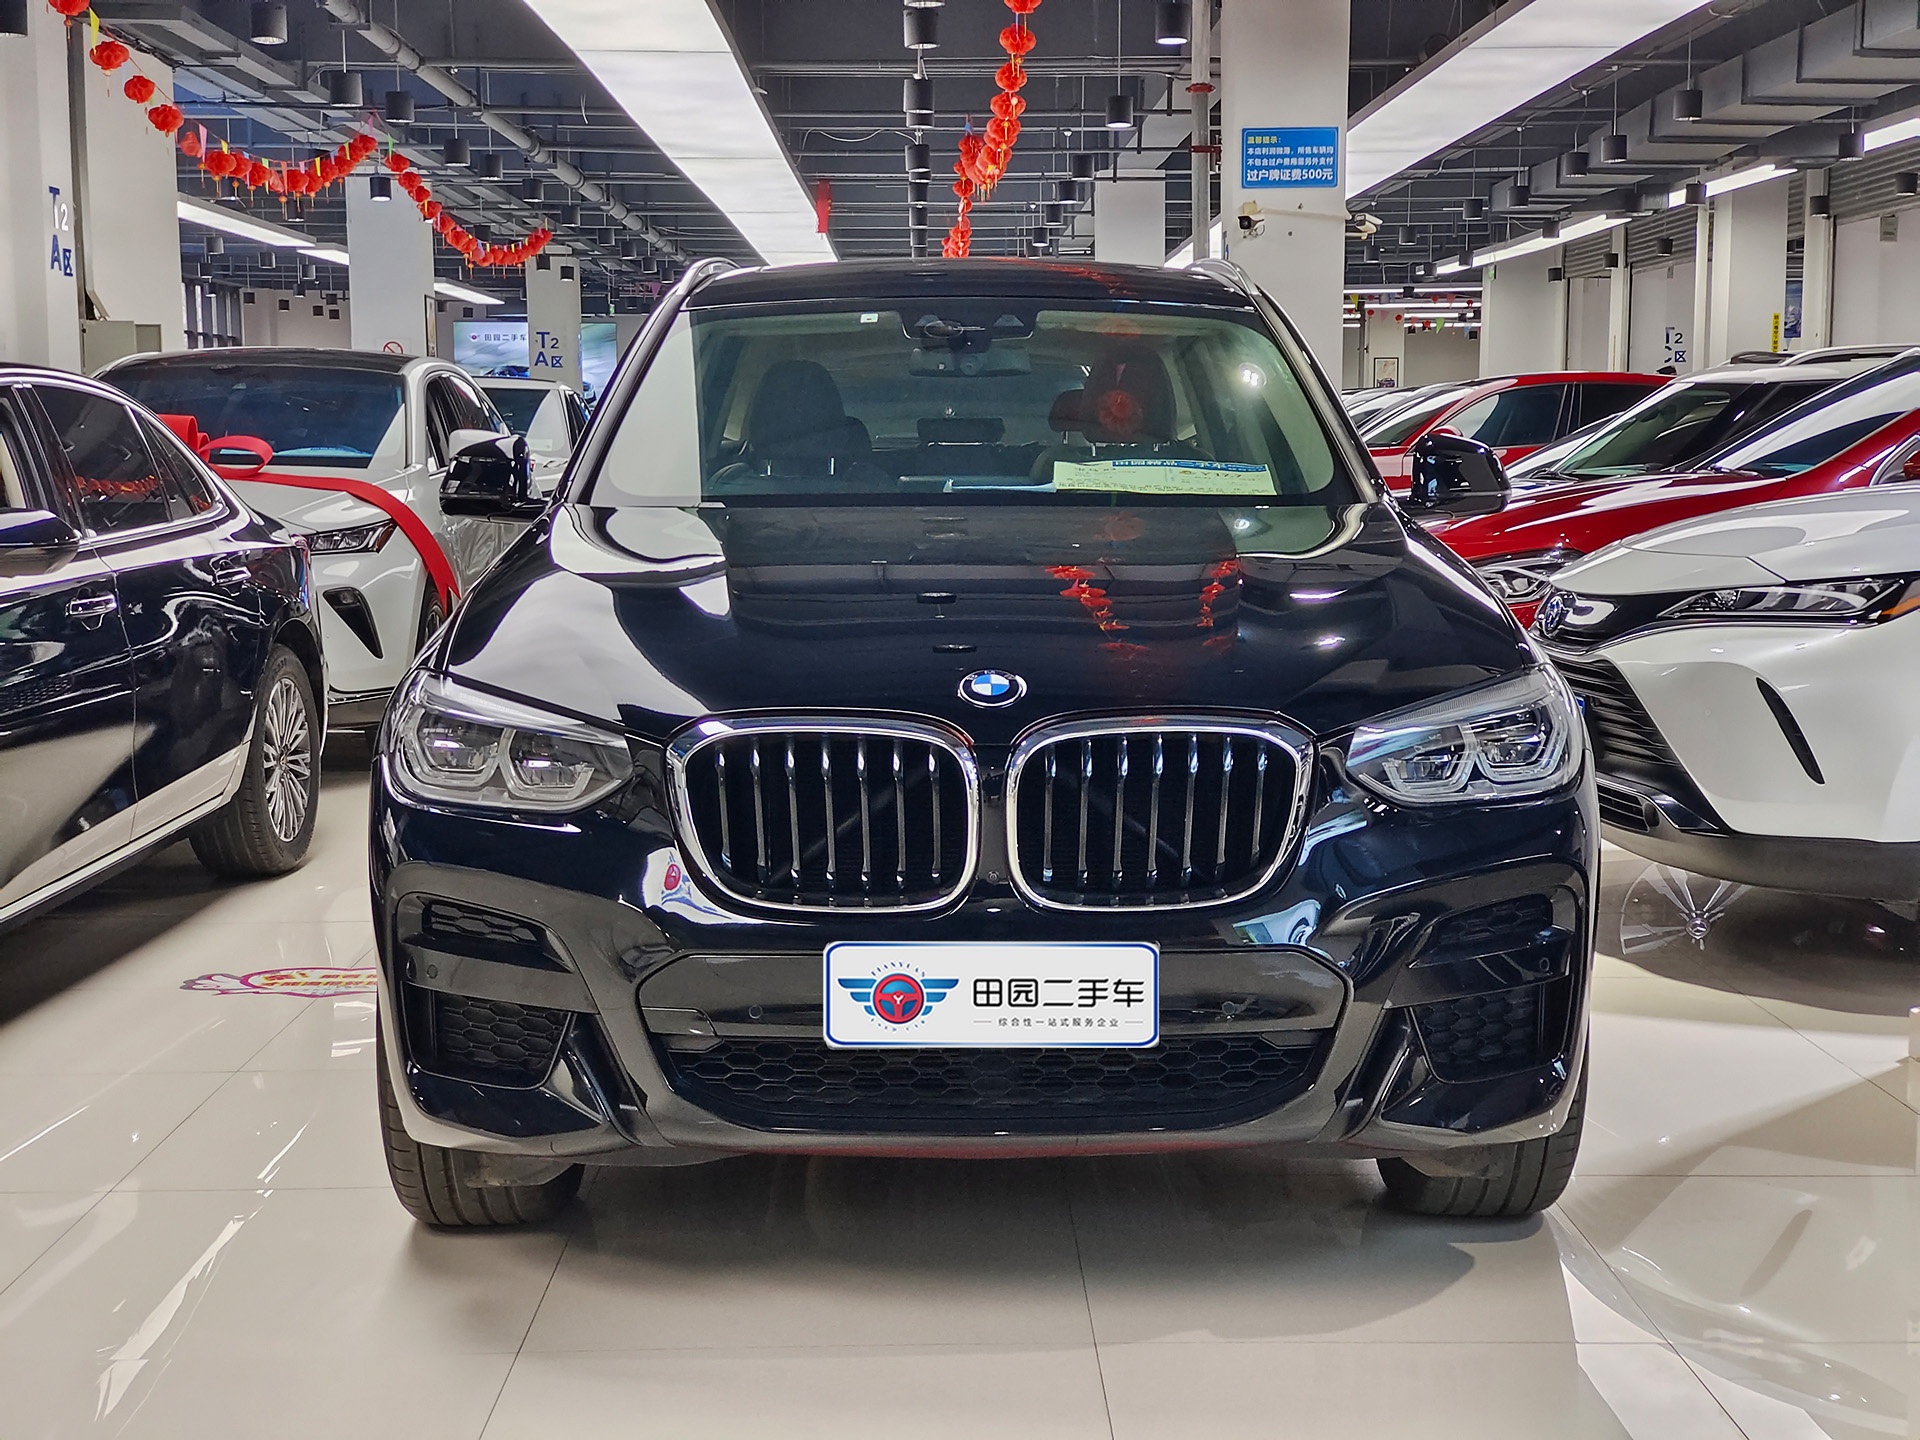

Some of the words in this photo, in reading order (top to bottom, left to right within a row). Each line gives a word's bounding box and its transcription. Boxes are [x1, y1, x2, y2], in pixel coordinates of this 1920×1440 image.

[1247, 168, 1334, 182] 过户牌证费500元
[536, 331, 559, 349] T2
[534, 351, 564, 368] A区
[973, 978, 1145, 1008] 田园二手车
[998, 1017, 1119, 1028] 综合性一站式服务企业
